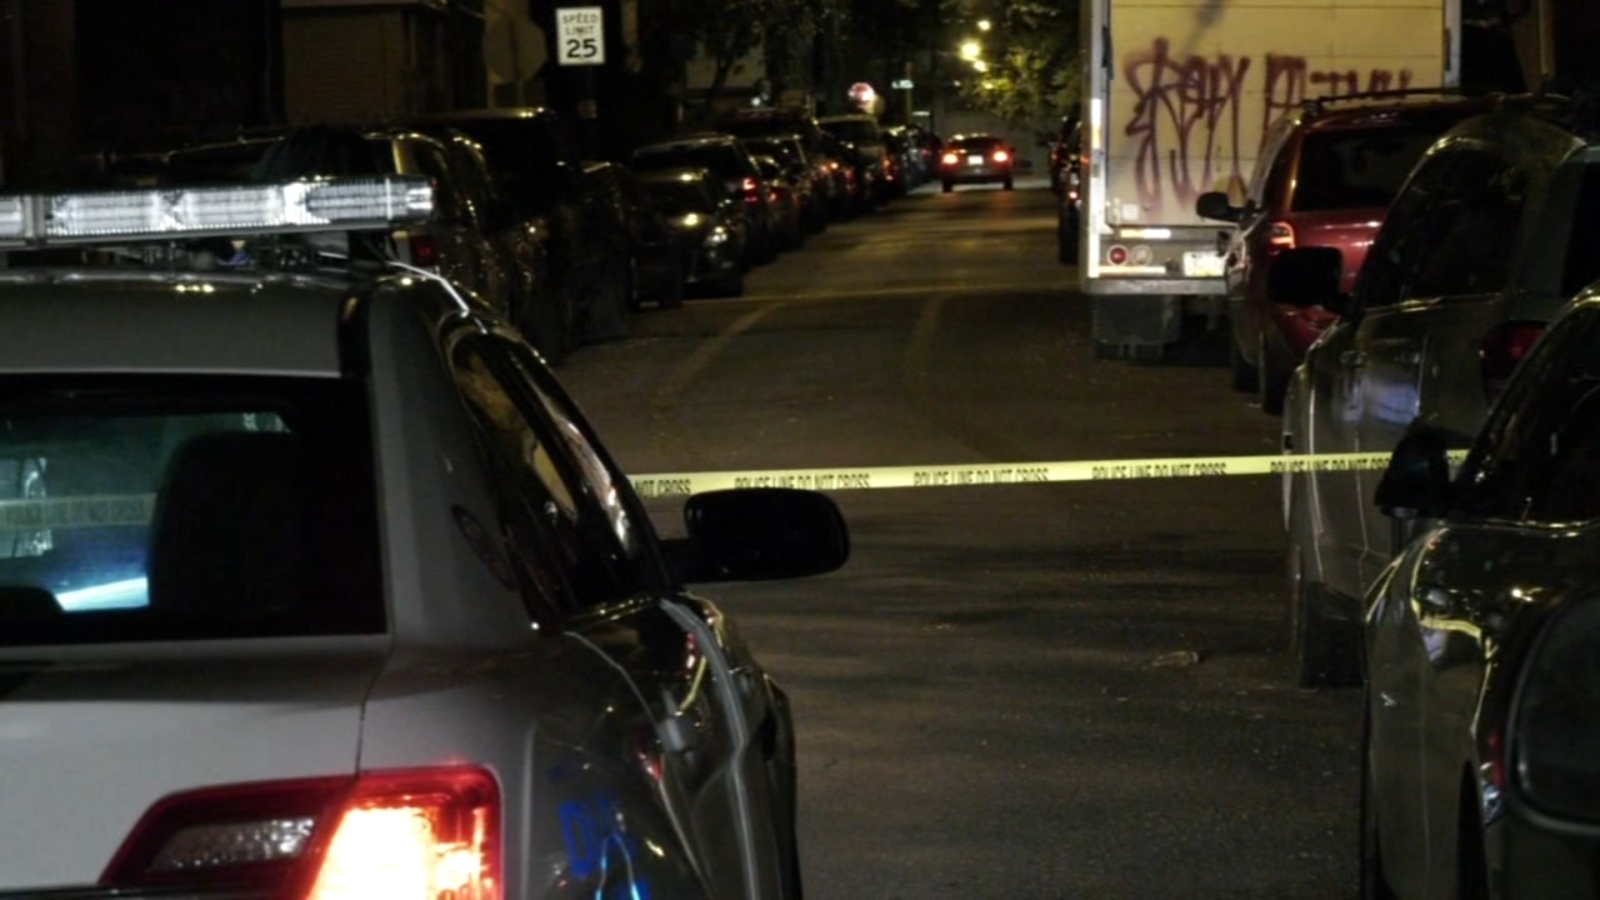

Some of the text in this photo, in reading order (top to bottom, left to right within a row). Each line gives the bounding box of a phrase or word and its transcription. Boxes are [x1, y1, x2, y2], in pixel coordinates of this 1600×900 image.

[566, 38, 597, 58] 25
[913, 466, 1048, 486] POLICE LINE DO NOT CROSS
[1092, 462, 1226, 480] POLICE LINE DO NOT CROSS
[735, 472, 869, 490] POLICE LINE DO NOT CROSS
